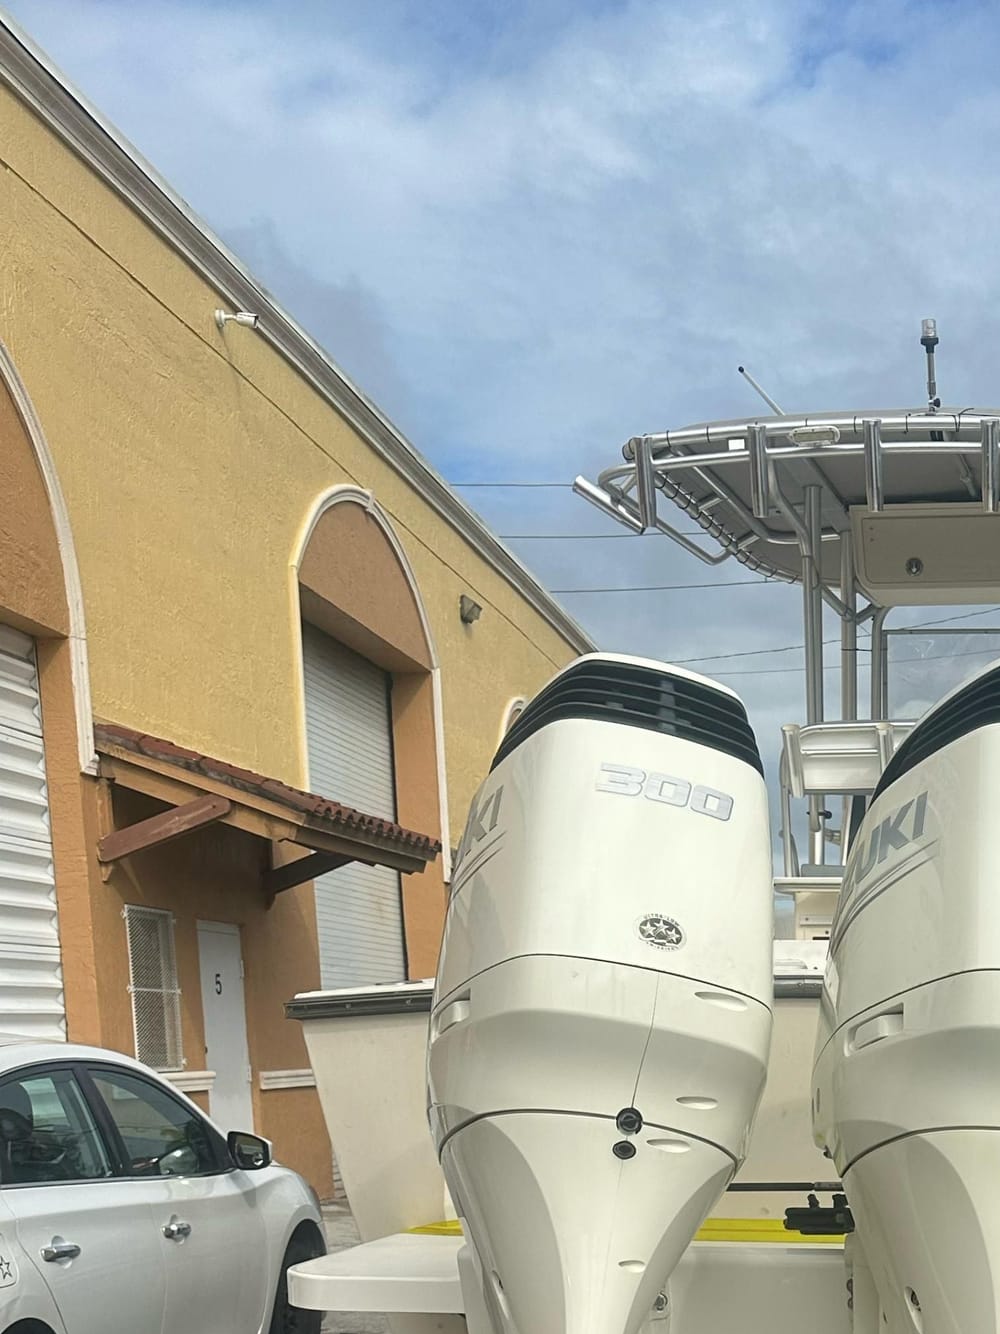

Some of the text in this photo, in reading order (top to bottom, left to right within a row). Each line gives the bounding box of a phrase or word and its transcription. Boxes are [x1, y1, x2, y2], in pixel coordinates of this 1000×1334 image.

[461, 784, 504, 857] KI
[595, 762, 734, 822] 300
[847, 790, 929, 896] UKI
[215, 973, 223, 996] 5
